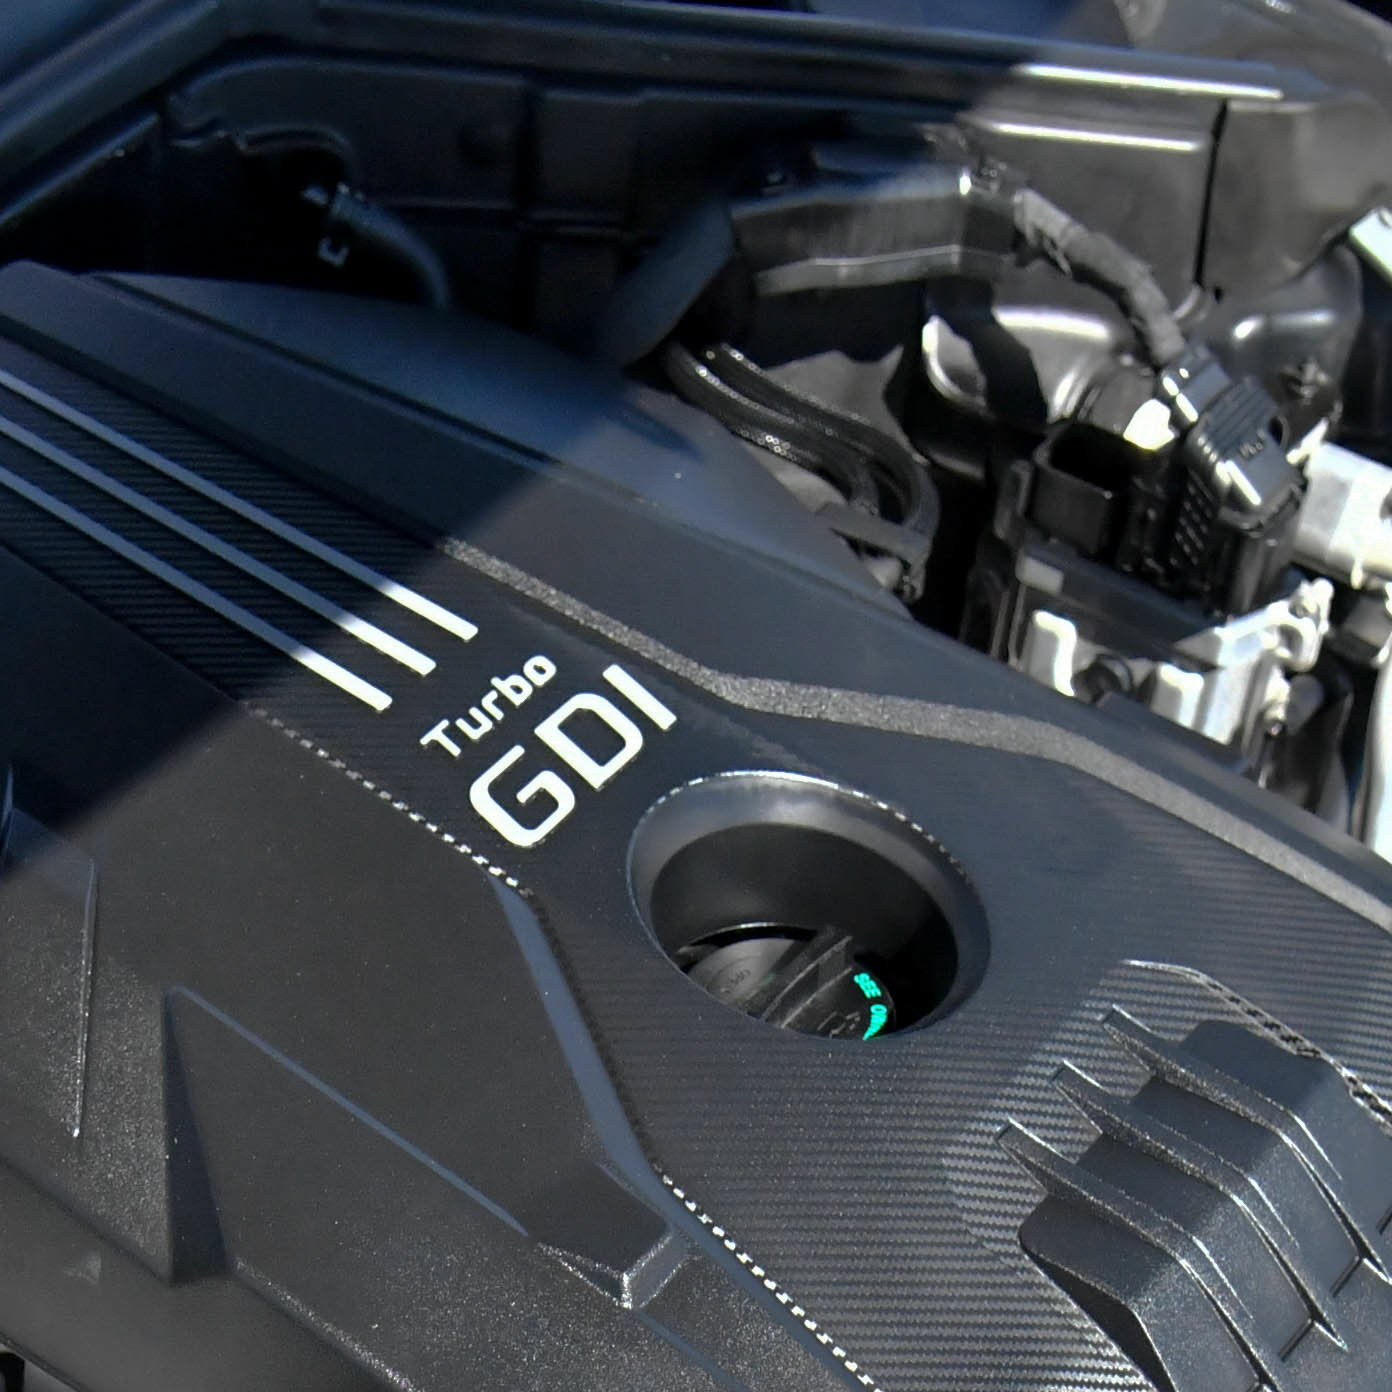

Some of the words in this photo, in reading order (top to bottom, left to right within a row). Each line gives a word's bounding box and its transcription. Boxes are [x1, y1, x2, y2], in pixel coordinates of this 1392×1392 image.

[419, 654, 557, 757] Turbo
[468, 663, 678, 848] GDI
[853, 972, 882, 999] SEE
